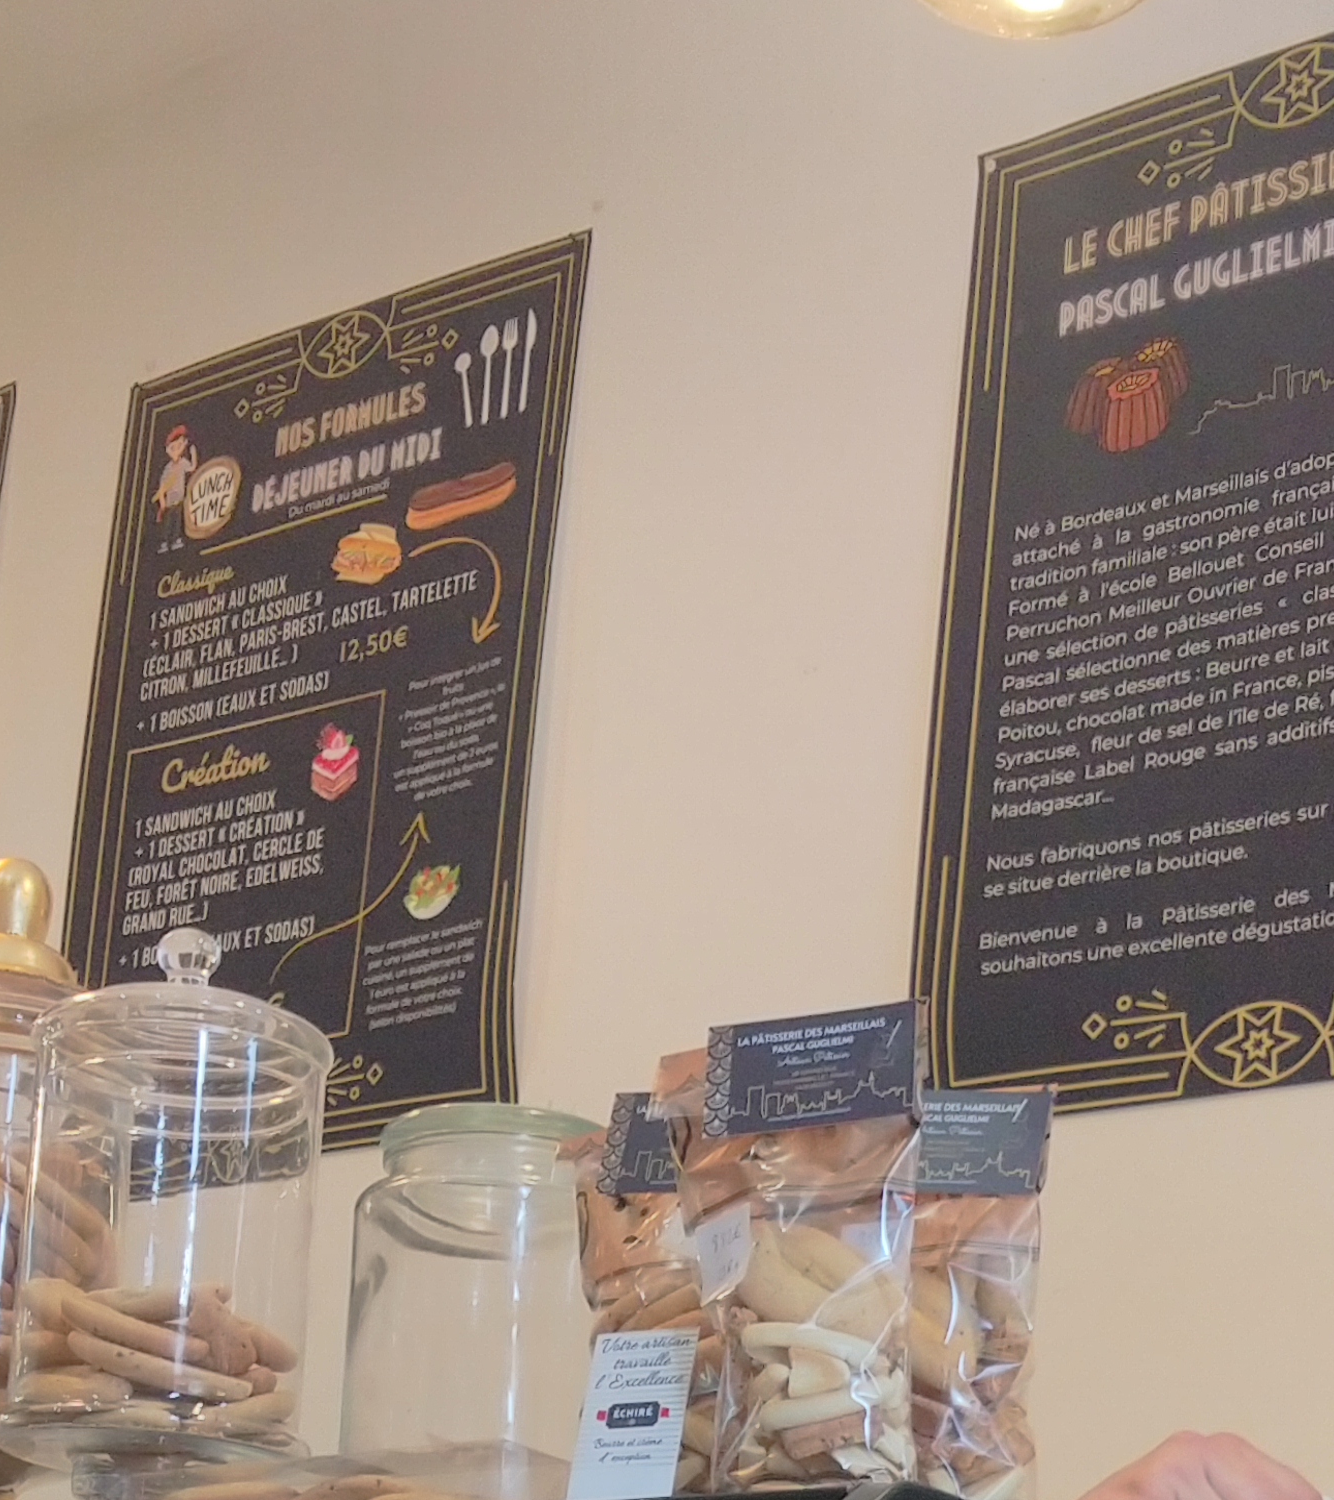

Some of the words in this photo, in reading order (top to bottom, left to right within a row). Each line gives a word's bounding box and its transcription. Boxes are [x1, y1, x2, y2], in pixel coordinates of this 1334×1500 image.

[1063, 228, 1097, 274] LE
[1106, 200, 1180, 257] CHEF
[1058, 273, 1165, 337] PASCAL
[274, 416, 315, 457] NOS
[319, 381, 425, 441] FORMULES
[191, 472, 233, 505] LUNCH
[251, 455, 353, 512] DÉJEUNER
[357, 444, 385, 480] DU
[390, 427, 442, 470] MIDI
[191, 494, 230, 526] TIME
[1014, 521, 1040, 541] Né
[1044, 518, 1056, 536] à
[1060, 499, 1146, 532] Bordeaux
[1150, 493, 1170, 510] et
[1174, 467, 1269, 505] Marseillais
[156, 565, 234, 598] Classique
[1008, 589, 1068, 616] Formé
[1077, 585, 1089, 603] à
[1100, 572, 1157, 598] l'école
[1167, 551, 1244, 583] Bellouet
[1254, 530, 1324, 562] Conseil
[150, 611, 156, 631] 1
[158, 591, 226, 628] SANDWICH
[227, 586, 246, 609] AU
[248, 574, 287, 603] CHOIX
[199, 637, 235, 664] FLAN,
[238, 610, 328, 653] PARIS-BREST,
[331, 596, 387, 628] CASTEL,
[391, 568, 478, 612] TARTELETTE
[1006, 611, 1102, 641] Perruchon
[1108, 593, 1181, 622] Meilleur
[1186, 576, 1256, 604] Ouvrier
[1262, 568, 1288, 586] de
[339, 624, 408, 662] 12,50€
[1001, 666, 1060, 692] Pascal
[1065, 647, 1172, 681] sélectionne
[1176, 639, 1211, 658] des
[1216, 619, 1300, 649] matières
[161, 743, 270, 793] Création
[135, 818, 142, 838] 1
[144, 803, 212, 836] SANDWICH
[213, 798, 233, 821] AU
[235, 789, 276, 816] CHOIX
[986, 852, 1034, 872] Nous
[1040, 835, 1141, 864] fabriquons
[1147, 829, 1182, 847] nos
[1188, 810, 1291, 844] pâtisseries
[1296, 802, 1328, 821] sur
[177, 843, 249, 877] CHOCOLAT,
[252, 831, 303, 861] CERCLE
[305, 826, 325, 850] DE
[983, 882, 1005, 898] se
[1007, 875, 1054, 895] situe
[1056, 863, 1132, 887] derrière
[1135, 858, 1152, 876] la
[1156, 844, 1248, 872] boutique.
[124, 888, 153, 911] FEU,
[155, 877, 198, 905] FORÊT
[199, 869, 241, 896] NOIRE,
[245, 852, 323, 887] EDELWEISS,
[978, 924, 1078, 950] Bienvenue
[1095, 916, 1107, 934] à
[1126, 912, 1143, 930] la
[1161, 895, 1256, 925] Pâtisserie
[1273, 888, 1310, 908] des
[980, 949, 1083, 975] souhaitons
[1086, 944, 1124, 961] une
[1127, 928, 1228, 956] excellente
[737, 1036, 750, 1047] LA
[751, 1028, 803, 1045] PÂTISSERIE
[803, 1026, 823, 1038] DES
[823, 1016, 886, 1036] MARSEILLAIS
[771, 1041, 805, 1054] PASCAL
[805, 1034, 854, 1049] GUGLIELMI
[601, 1337, 638, 1354] Votre
[640, 1335, 691, 1349] artisan
[612, 1350, 671, 1370] travaille
[612, 1403, 654, 1421] ÉCHIRÉ
